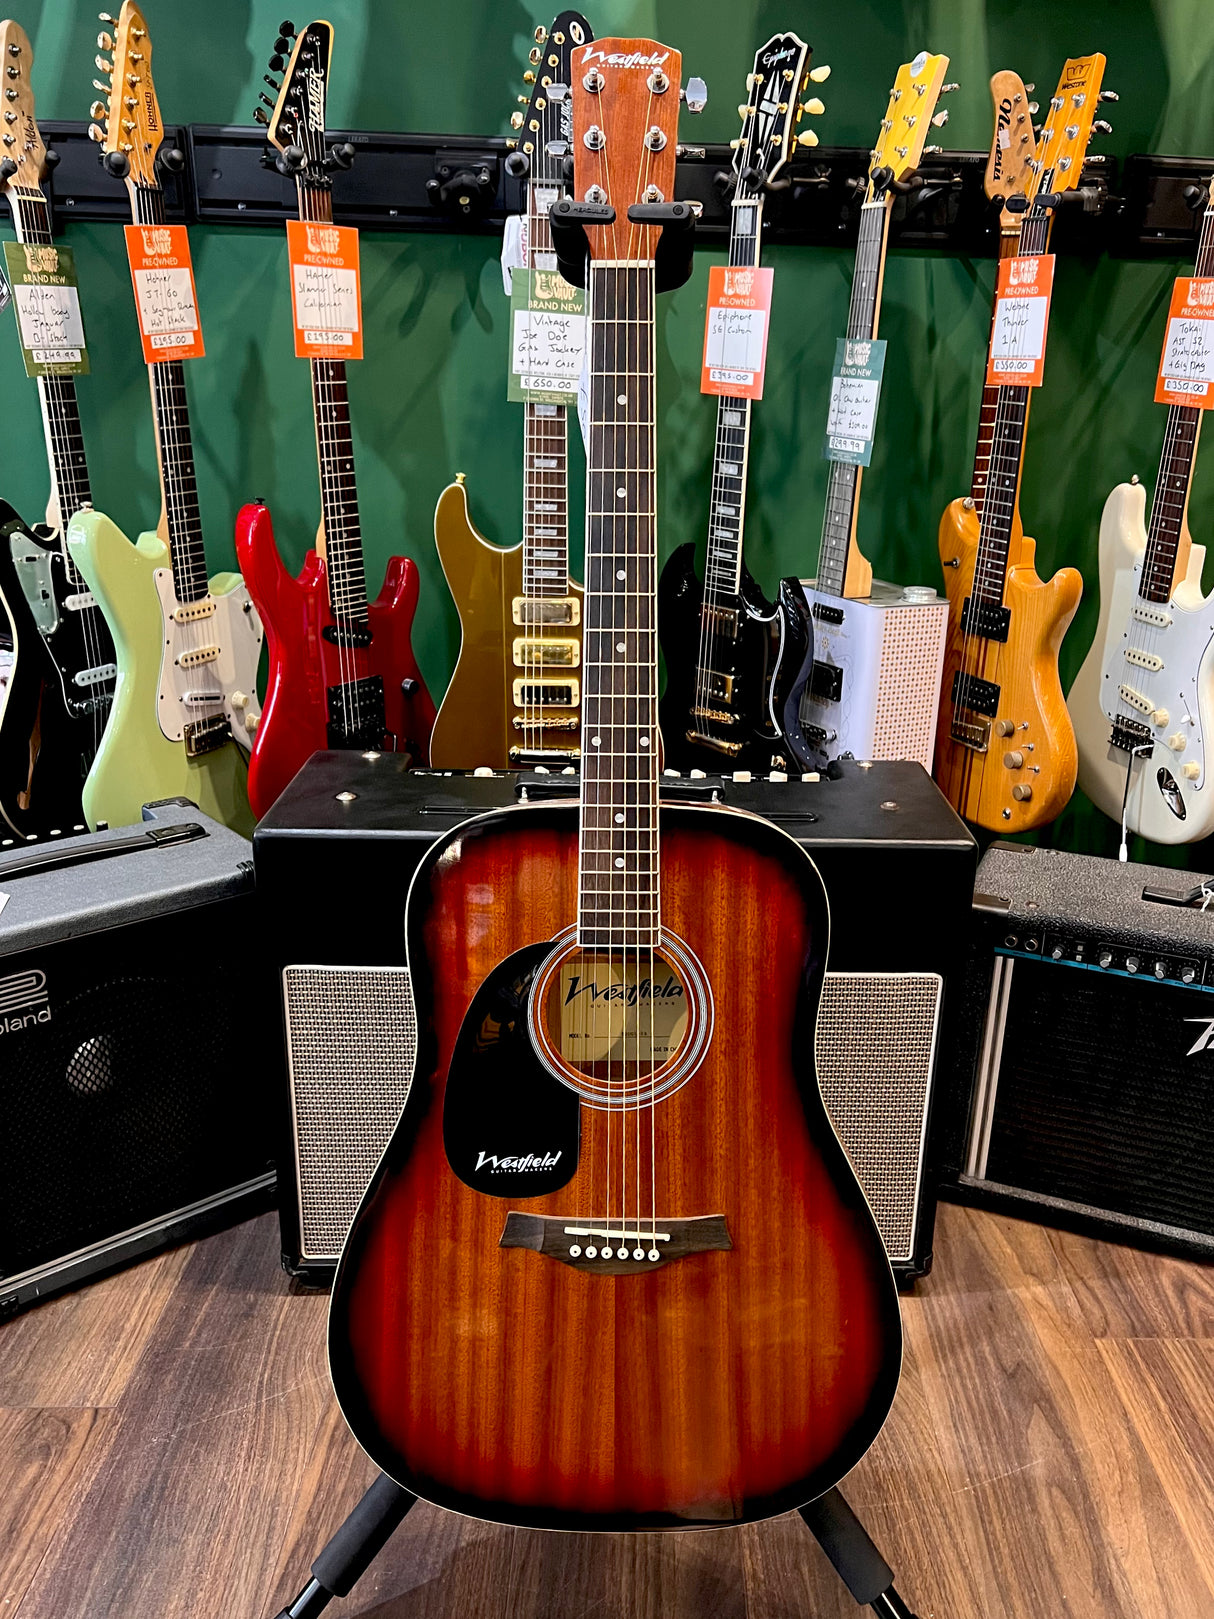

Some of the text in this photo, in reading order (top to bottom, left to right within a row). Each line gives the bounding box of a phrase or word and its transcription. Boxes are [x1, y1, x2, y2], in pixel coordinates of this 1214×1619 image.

[581, 46, 670, 68] Westfield
[309, 67, 325, 132] HAMER
[23, 274, 66, 284] BRAND NEW
[528, 300, 583, 313] BRAND NEW
[533, 314, 571, 333] Vintage
[521, 329, 568, 341] Joe Doe
[857, 368, 872, 377] NEW
[564, 976, 684, 1007] Westfield
[474, 1150, 562, 1173] Westfield
